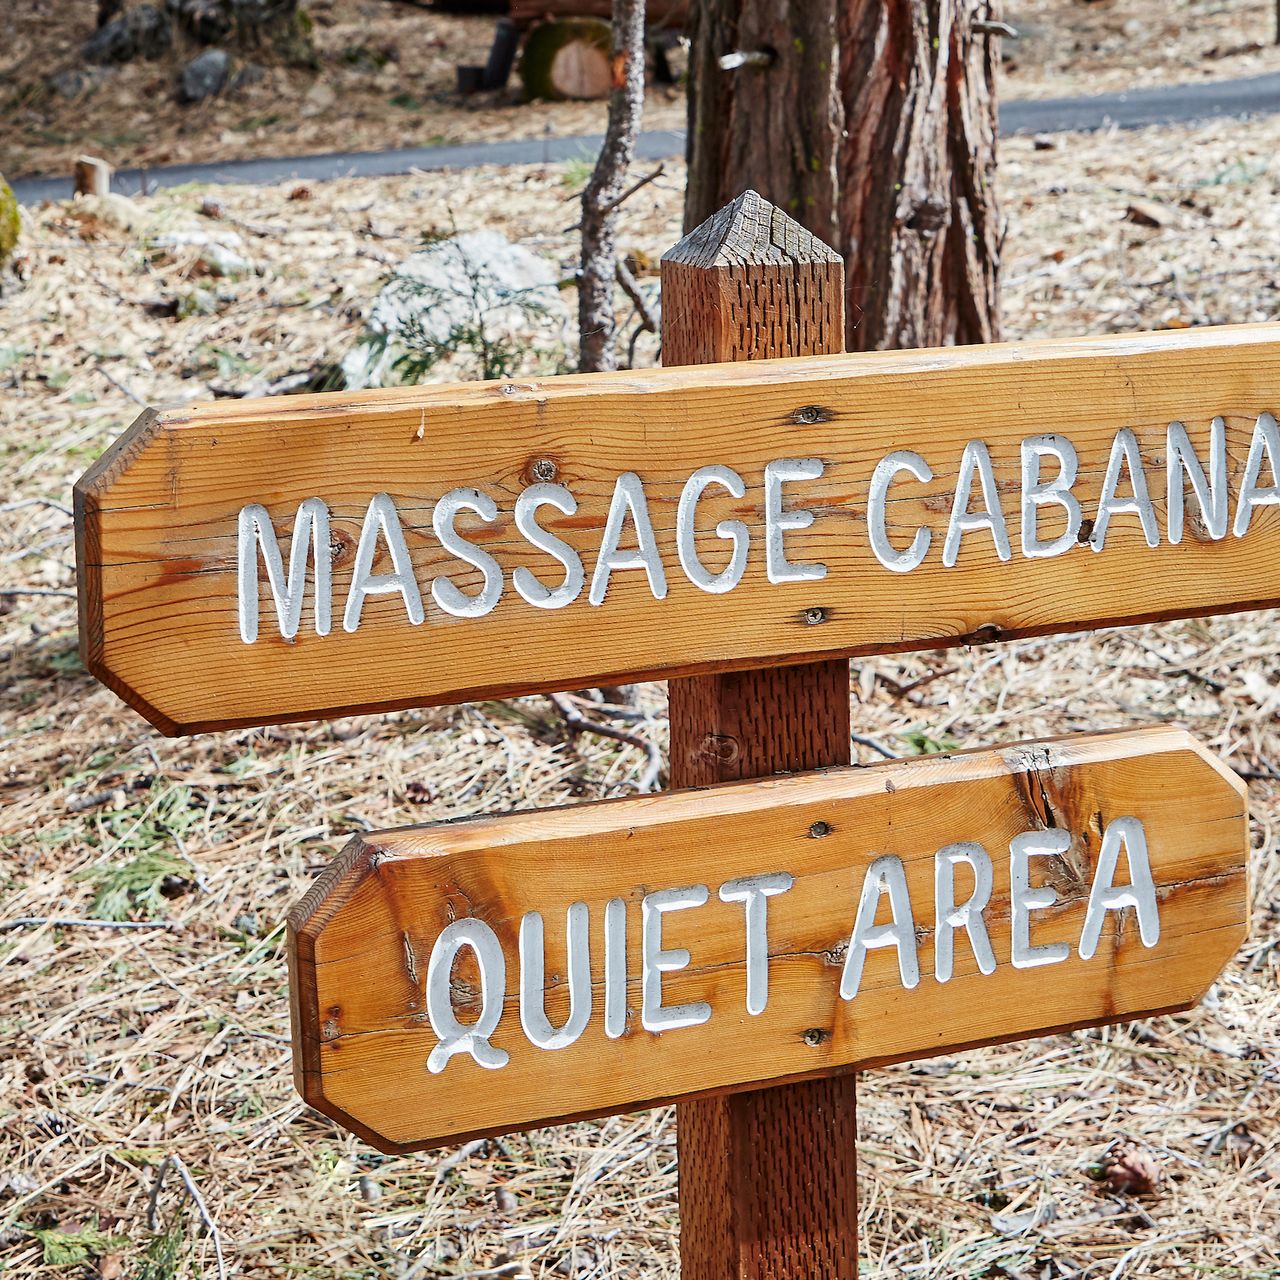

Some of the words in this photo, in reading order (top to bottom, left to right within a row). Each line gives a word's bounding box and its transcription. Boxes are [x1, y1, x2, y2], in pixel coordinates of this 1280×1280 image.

[237, 457, 828, 645] MASSAGE
[425, 870, 794, 1074] QUIET
[838, 815, 1160, 1001] AREA
